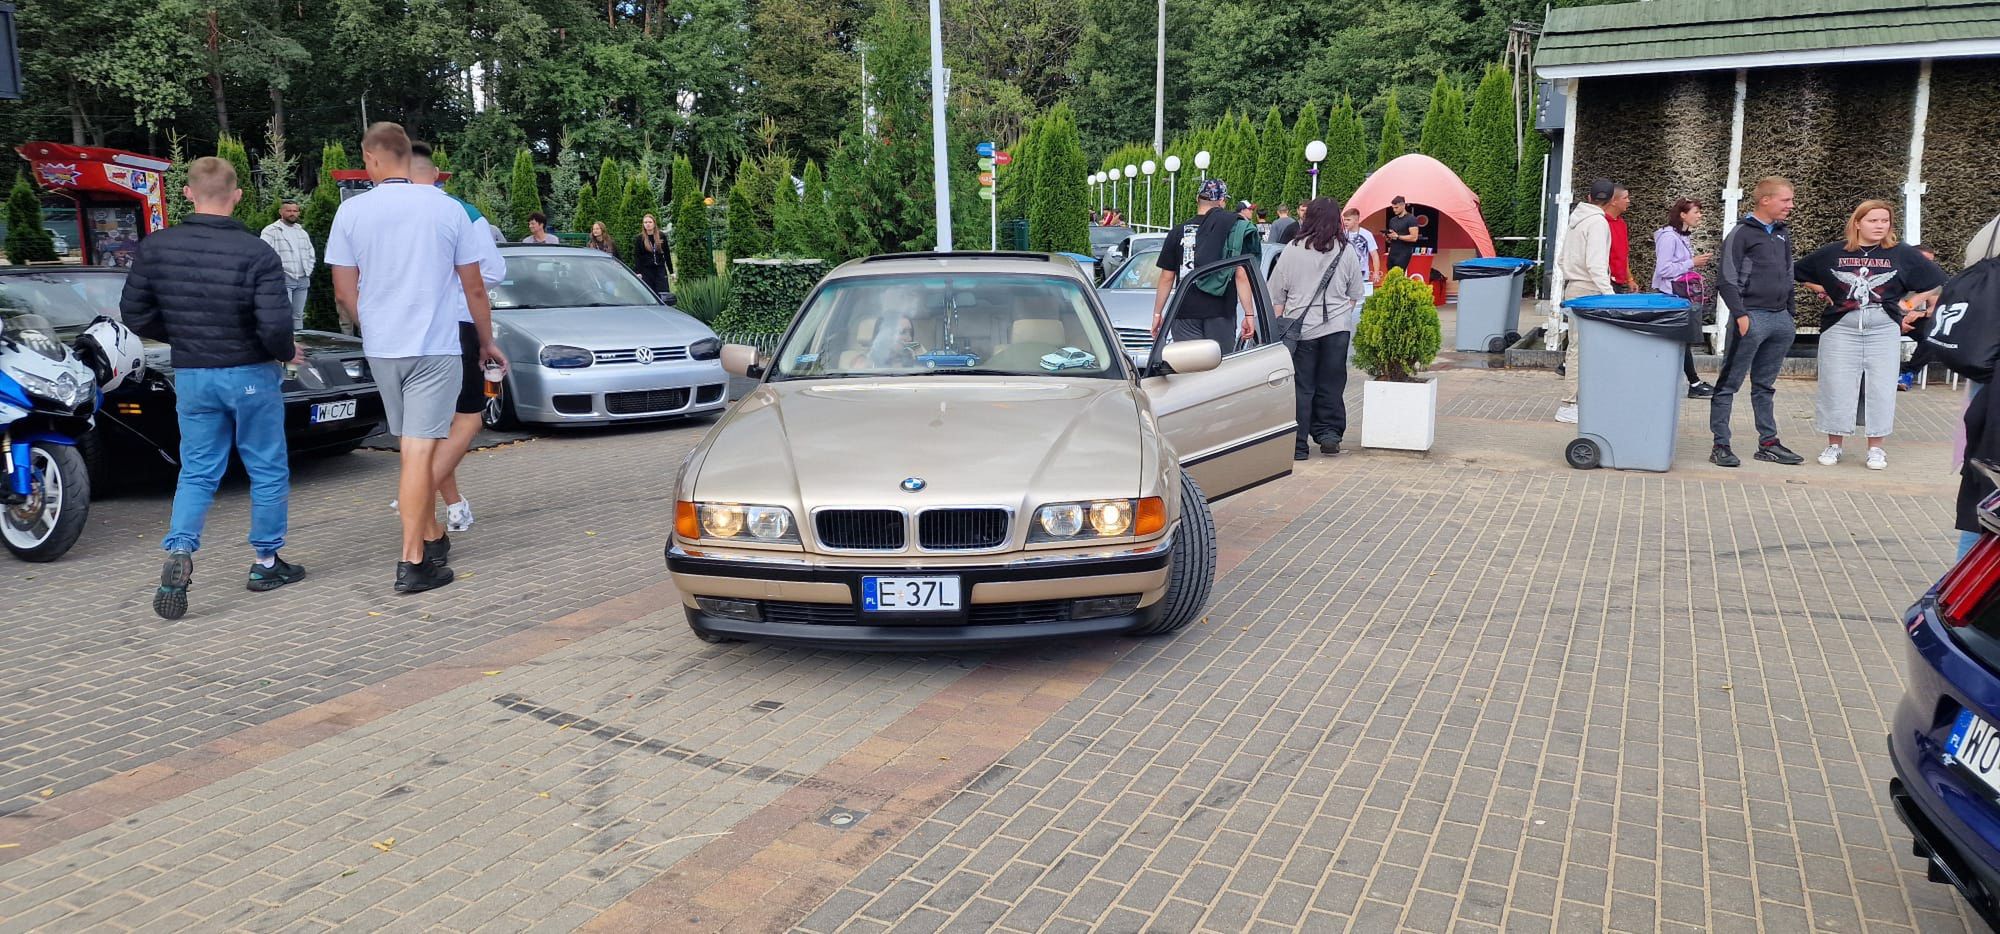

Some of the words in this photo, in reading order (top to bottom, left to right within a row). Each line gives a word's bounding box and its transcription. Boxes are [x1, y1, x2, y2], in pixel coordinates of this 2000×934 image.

[1838, 257, 1892, 268] NIRVANA
[319, 405, 327, 421] W
[331, 402, 354, 418] C7C
[866, 597, 876, 605] PL
[879, 581, 895, 606] E
[906, 581, 954, 606] 37L
